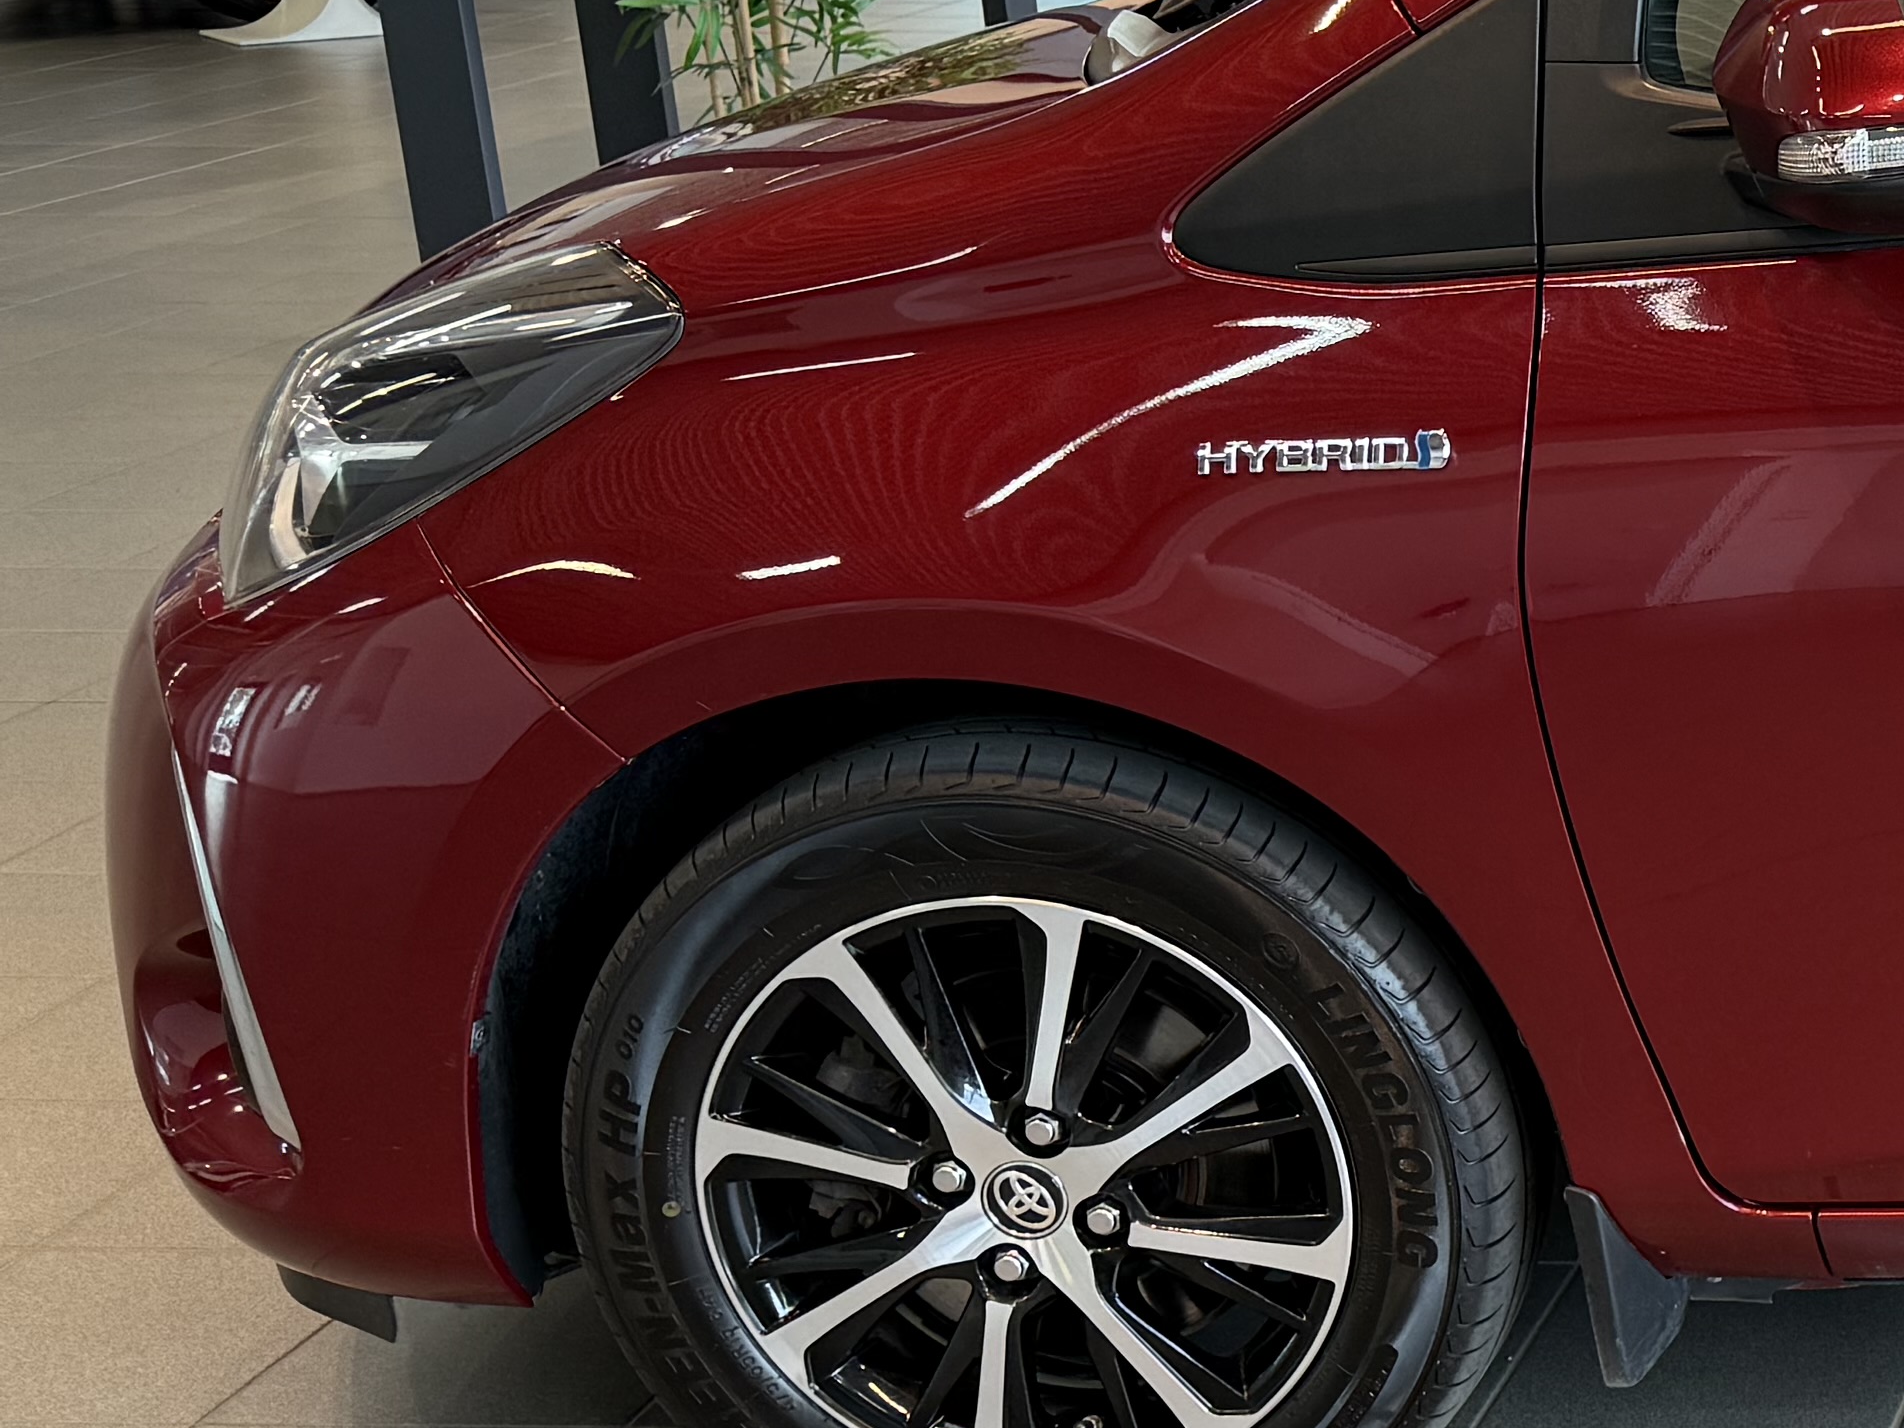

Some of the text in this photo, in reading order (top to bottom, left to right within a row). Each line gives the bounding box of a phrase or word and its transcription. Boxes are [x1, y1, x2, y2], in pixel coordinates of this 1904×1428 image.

[1197, 437, 1409, 475] HYBRID
[598, 1072, 644, 1158] HP
[1309, 981, 1439, 1269] LINGLONG
